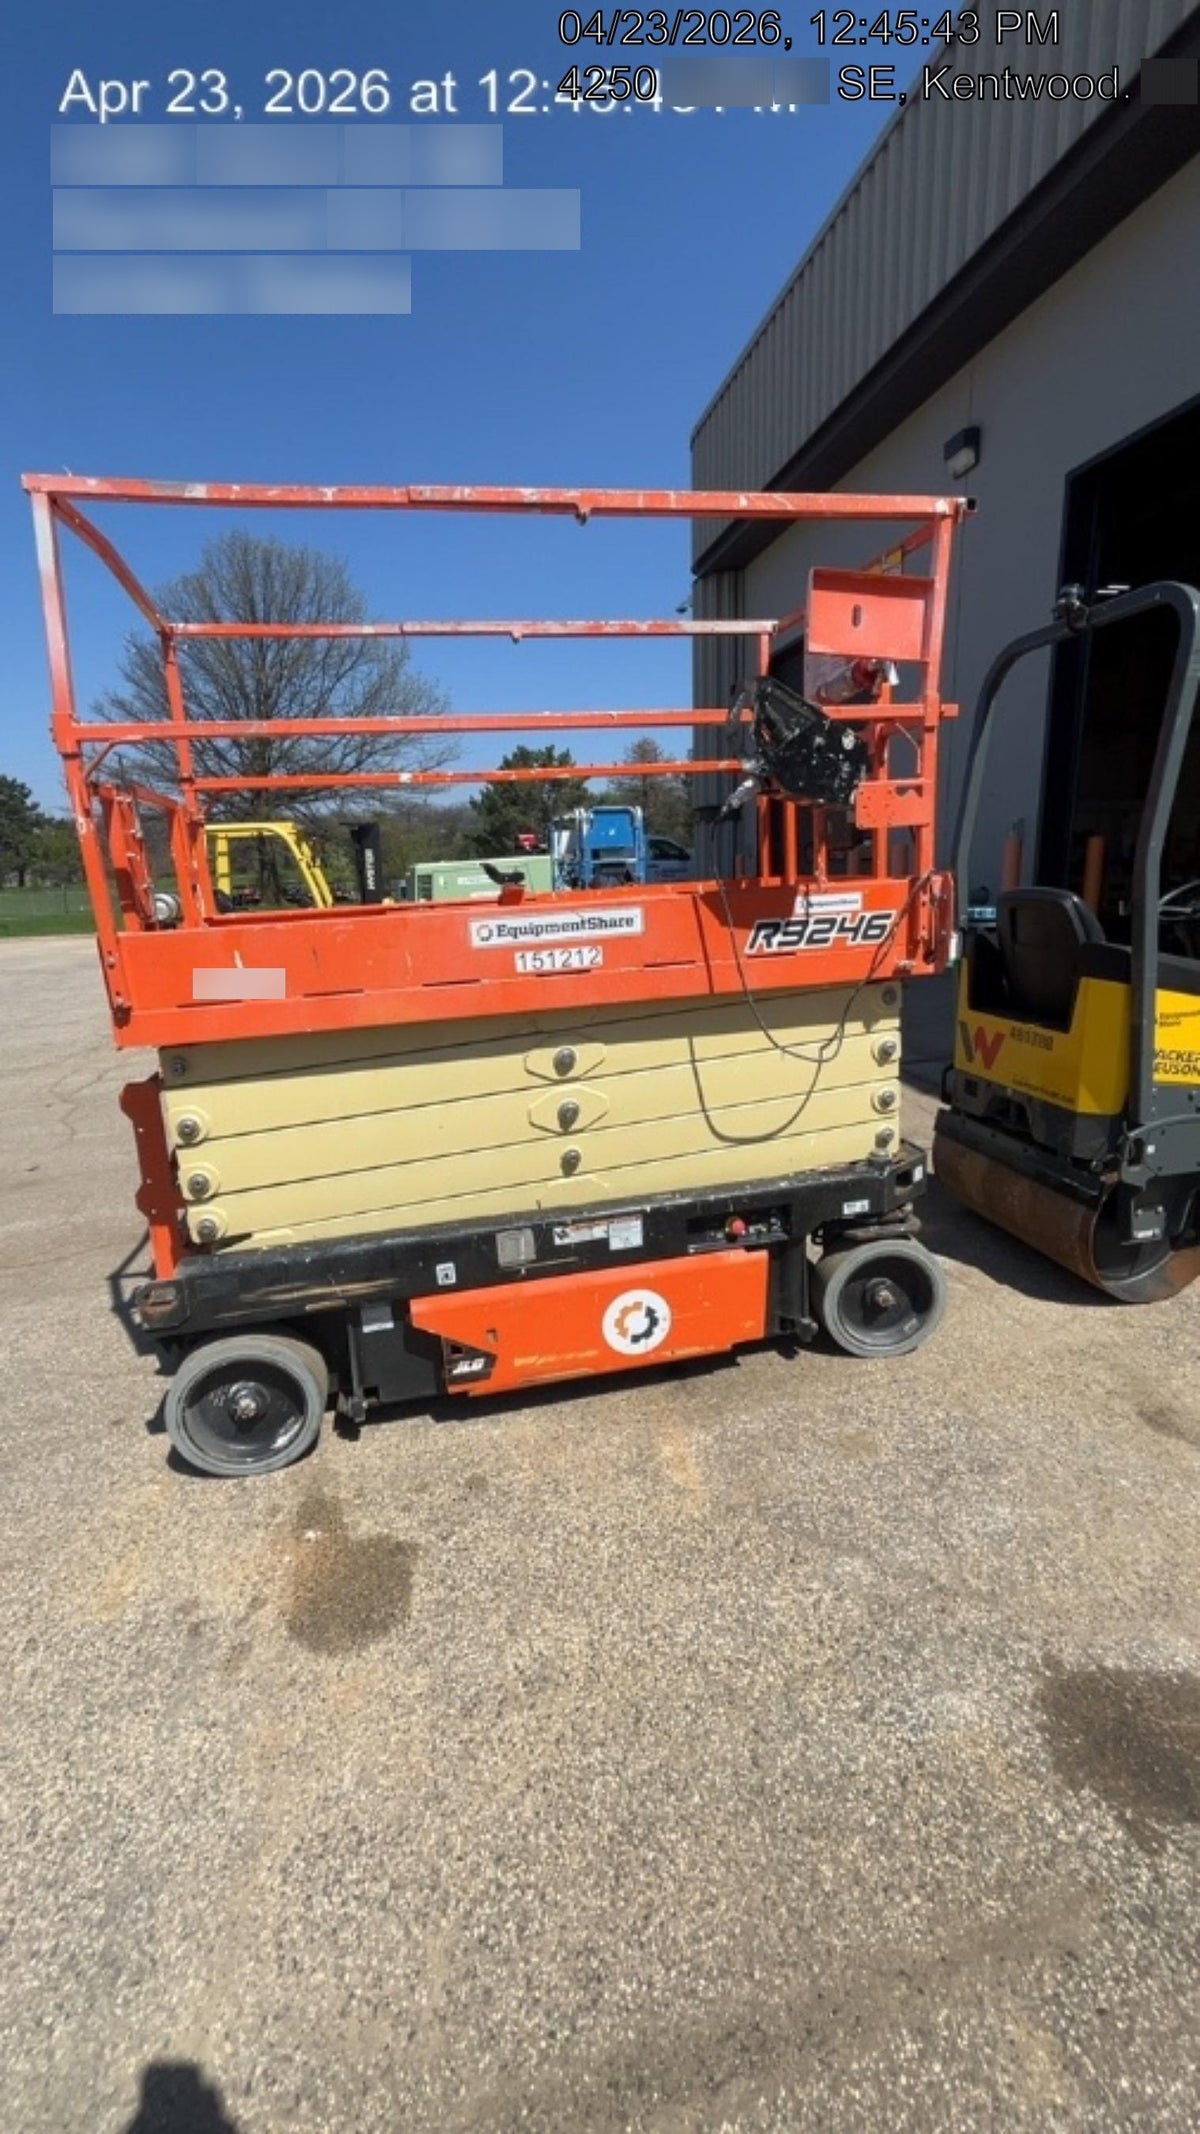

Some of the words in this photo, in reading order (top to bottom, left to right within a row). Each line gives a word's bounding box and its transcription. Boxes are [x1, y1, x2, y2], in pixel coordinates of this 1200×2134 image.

[364, 848, 376, 891] HYSTER
[496, 915, 635, 939] EquipmentShare
[749, 911, 893, 950] R9246
[518, 948, 600, 971] 151212
